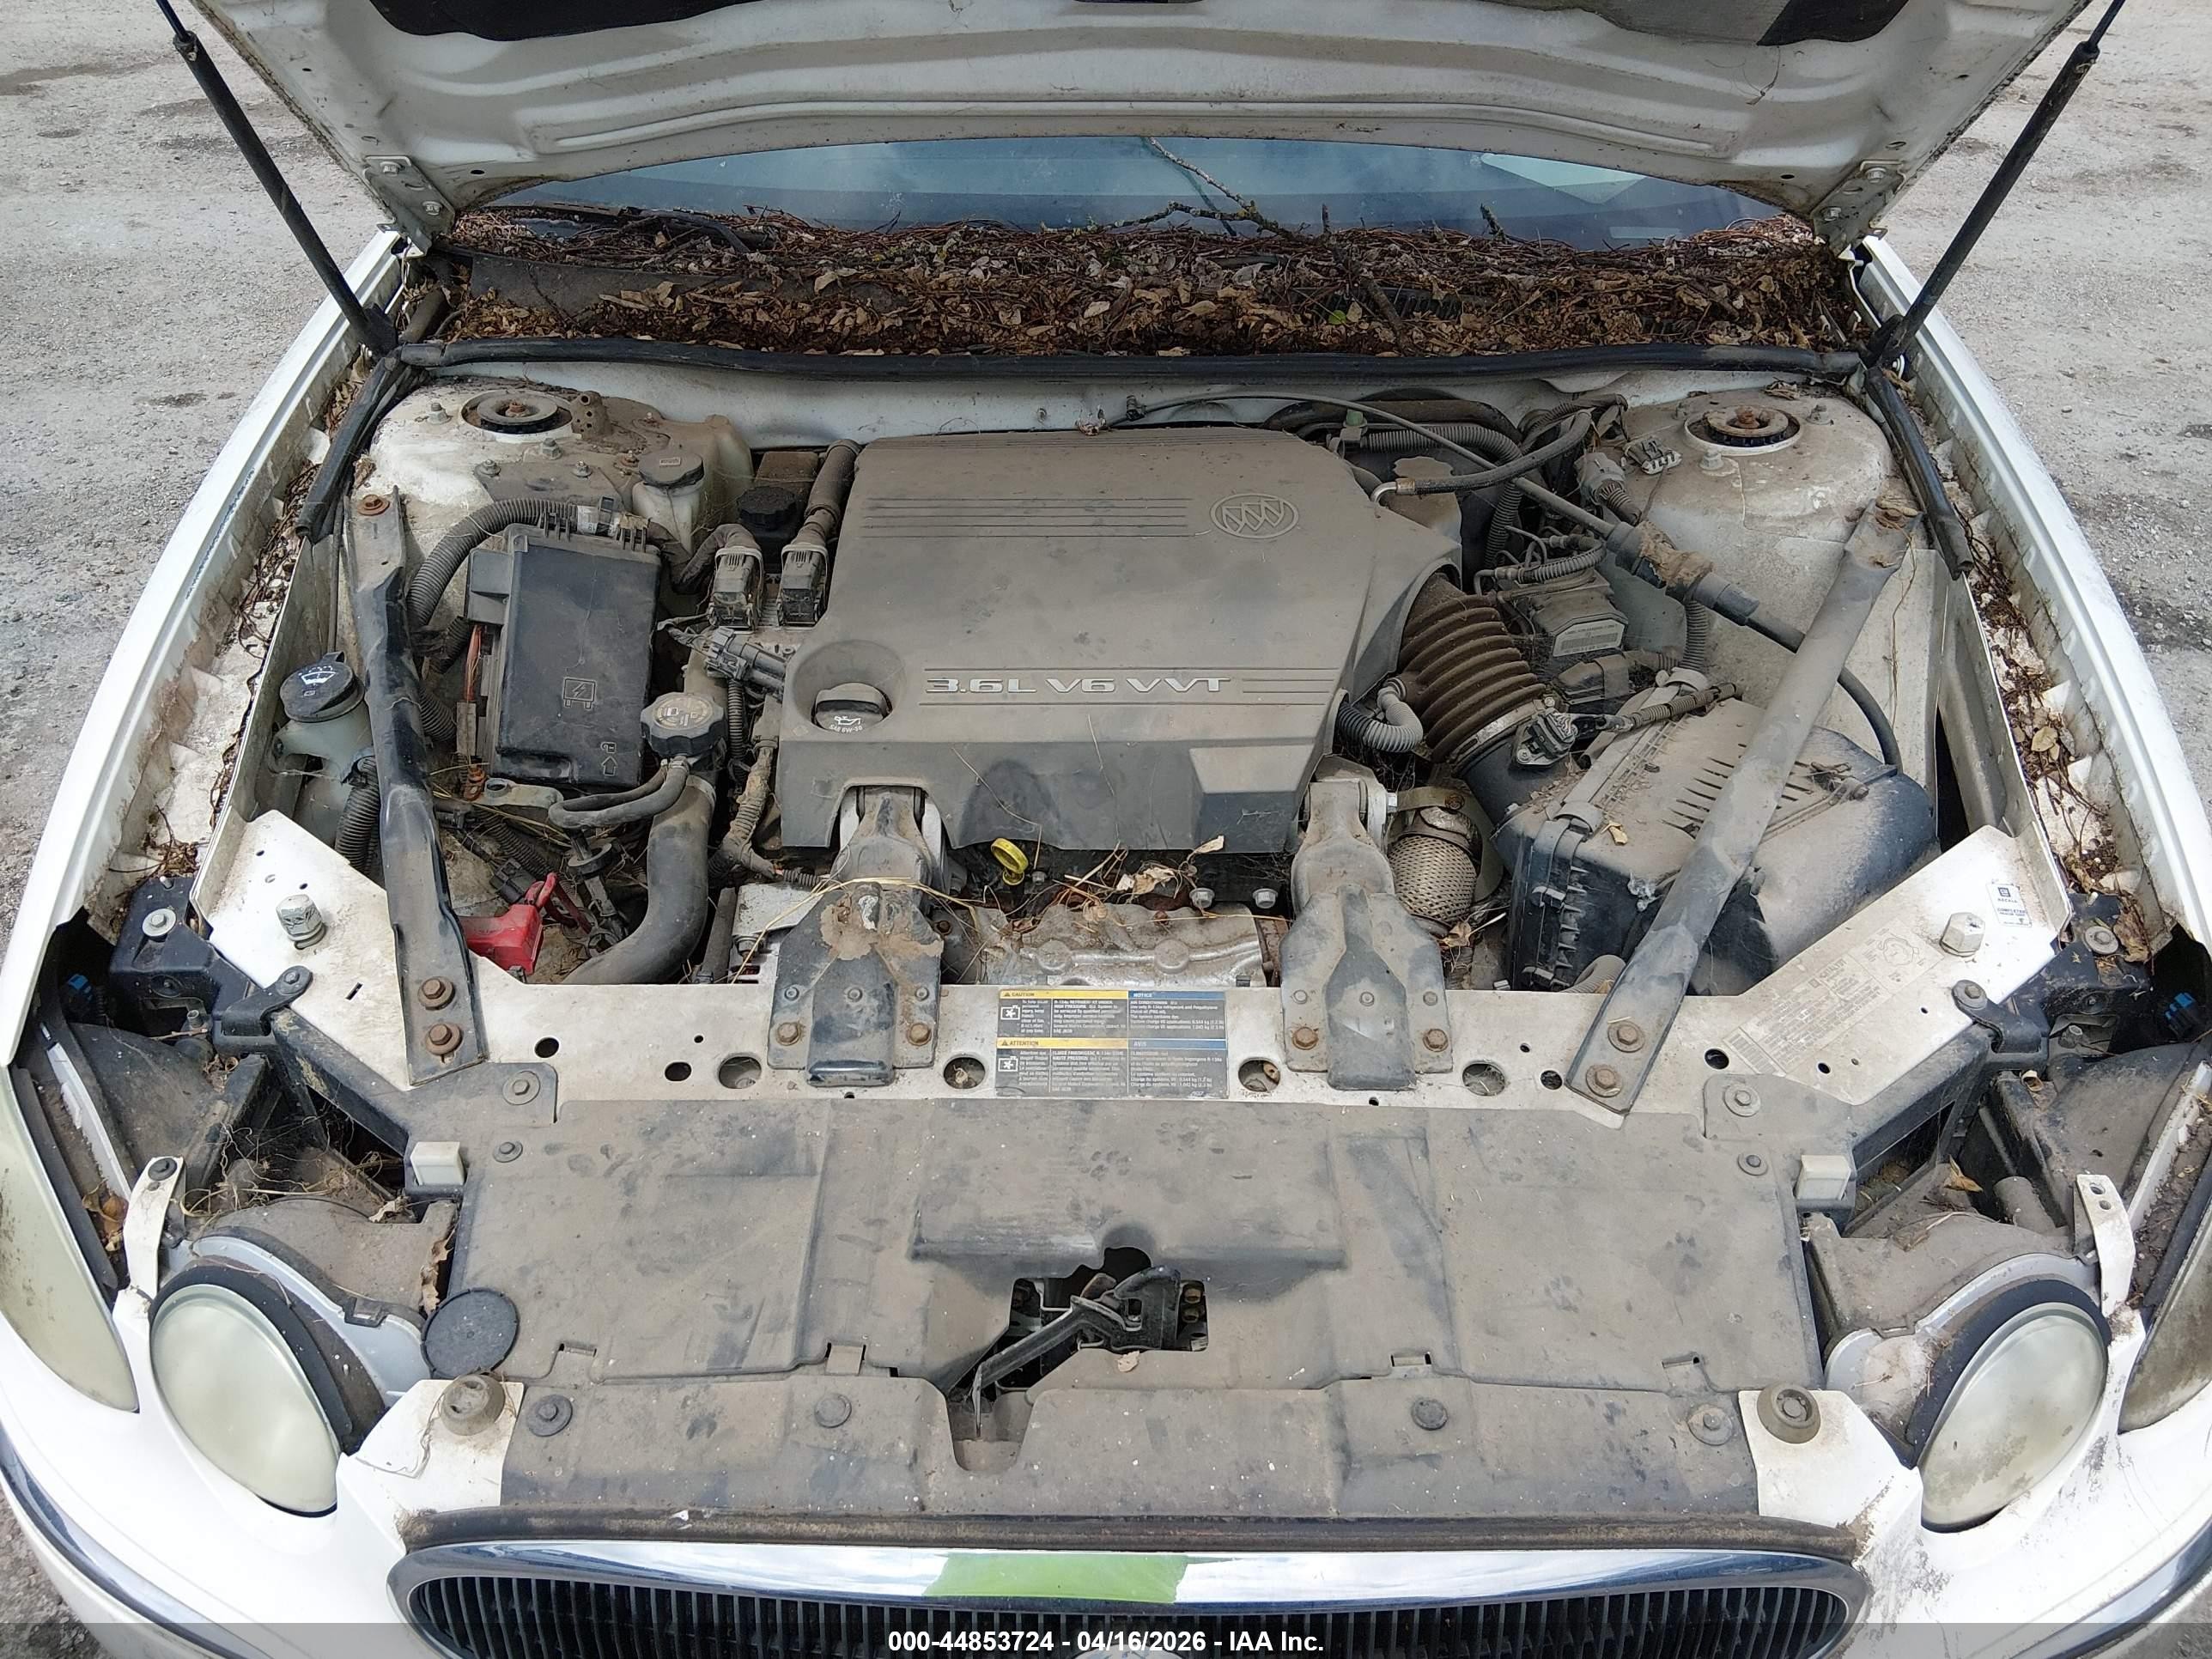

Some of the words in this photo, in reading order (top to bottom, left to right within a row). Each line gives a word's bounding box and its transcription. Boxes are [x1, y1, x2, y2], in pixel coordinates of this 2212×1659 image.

[926, 678, 1037, 694] 3.6L
[1045, 678, 1115, 694] V6
[1126, 677, 1231, 693] VVT
